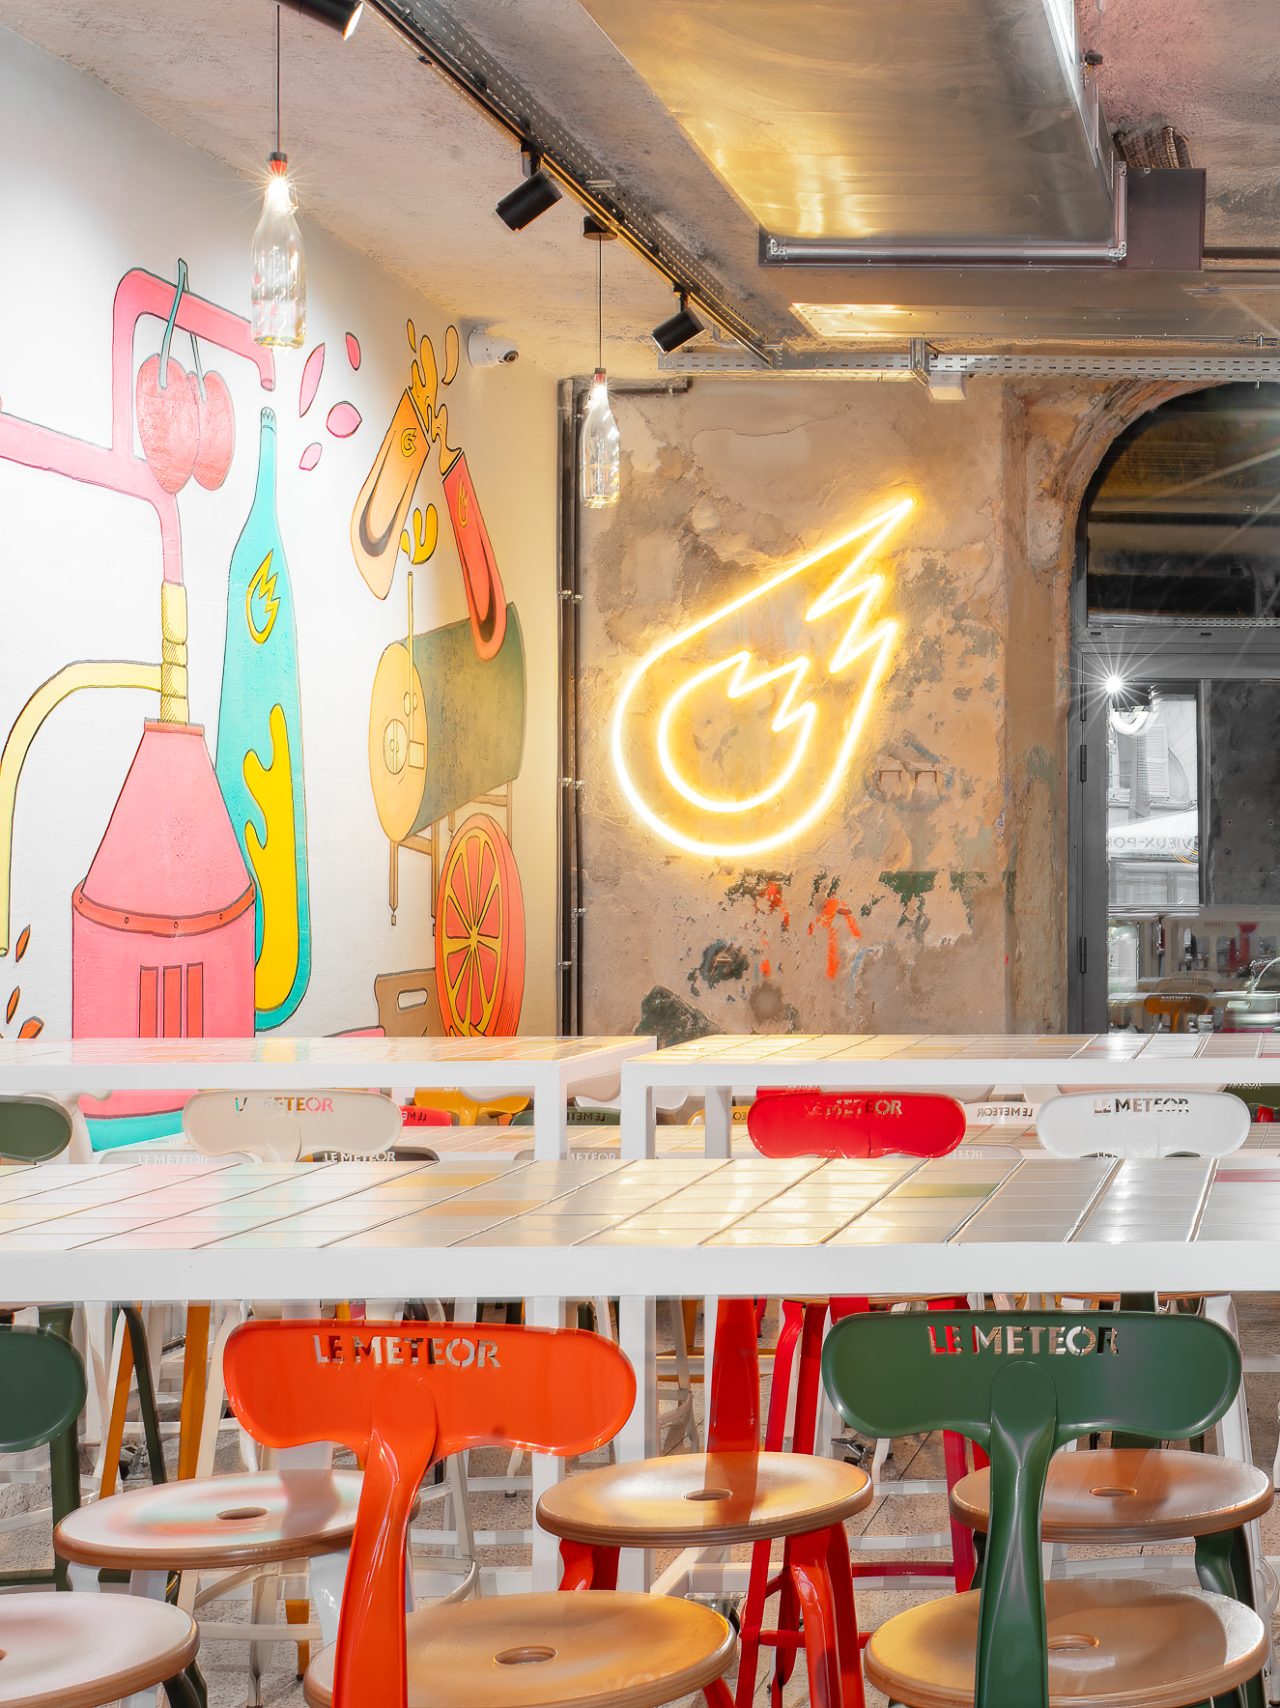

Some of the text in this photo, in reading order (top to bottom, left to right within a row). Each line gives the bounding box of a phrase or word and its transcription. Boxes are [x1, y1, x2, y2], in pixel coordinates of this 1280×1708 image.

[1115, 1098, 1190, 1112] METEOR
[313, 1334, 501, 1368] LE METEOR
[927, 1325, 1119, 1356] LE METEOR
